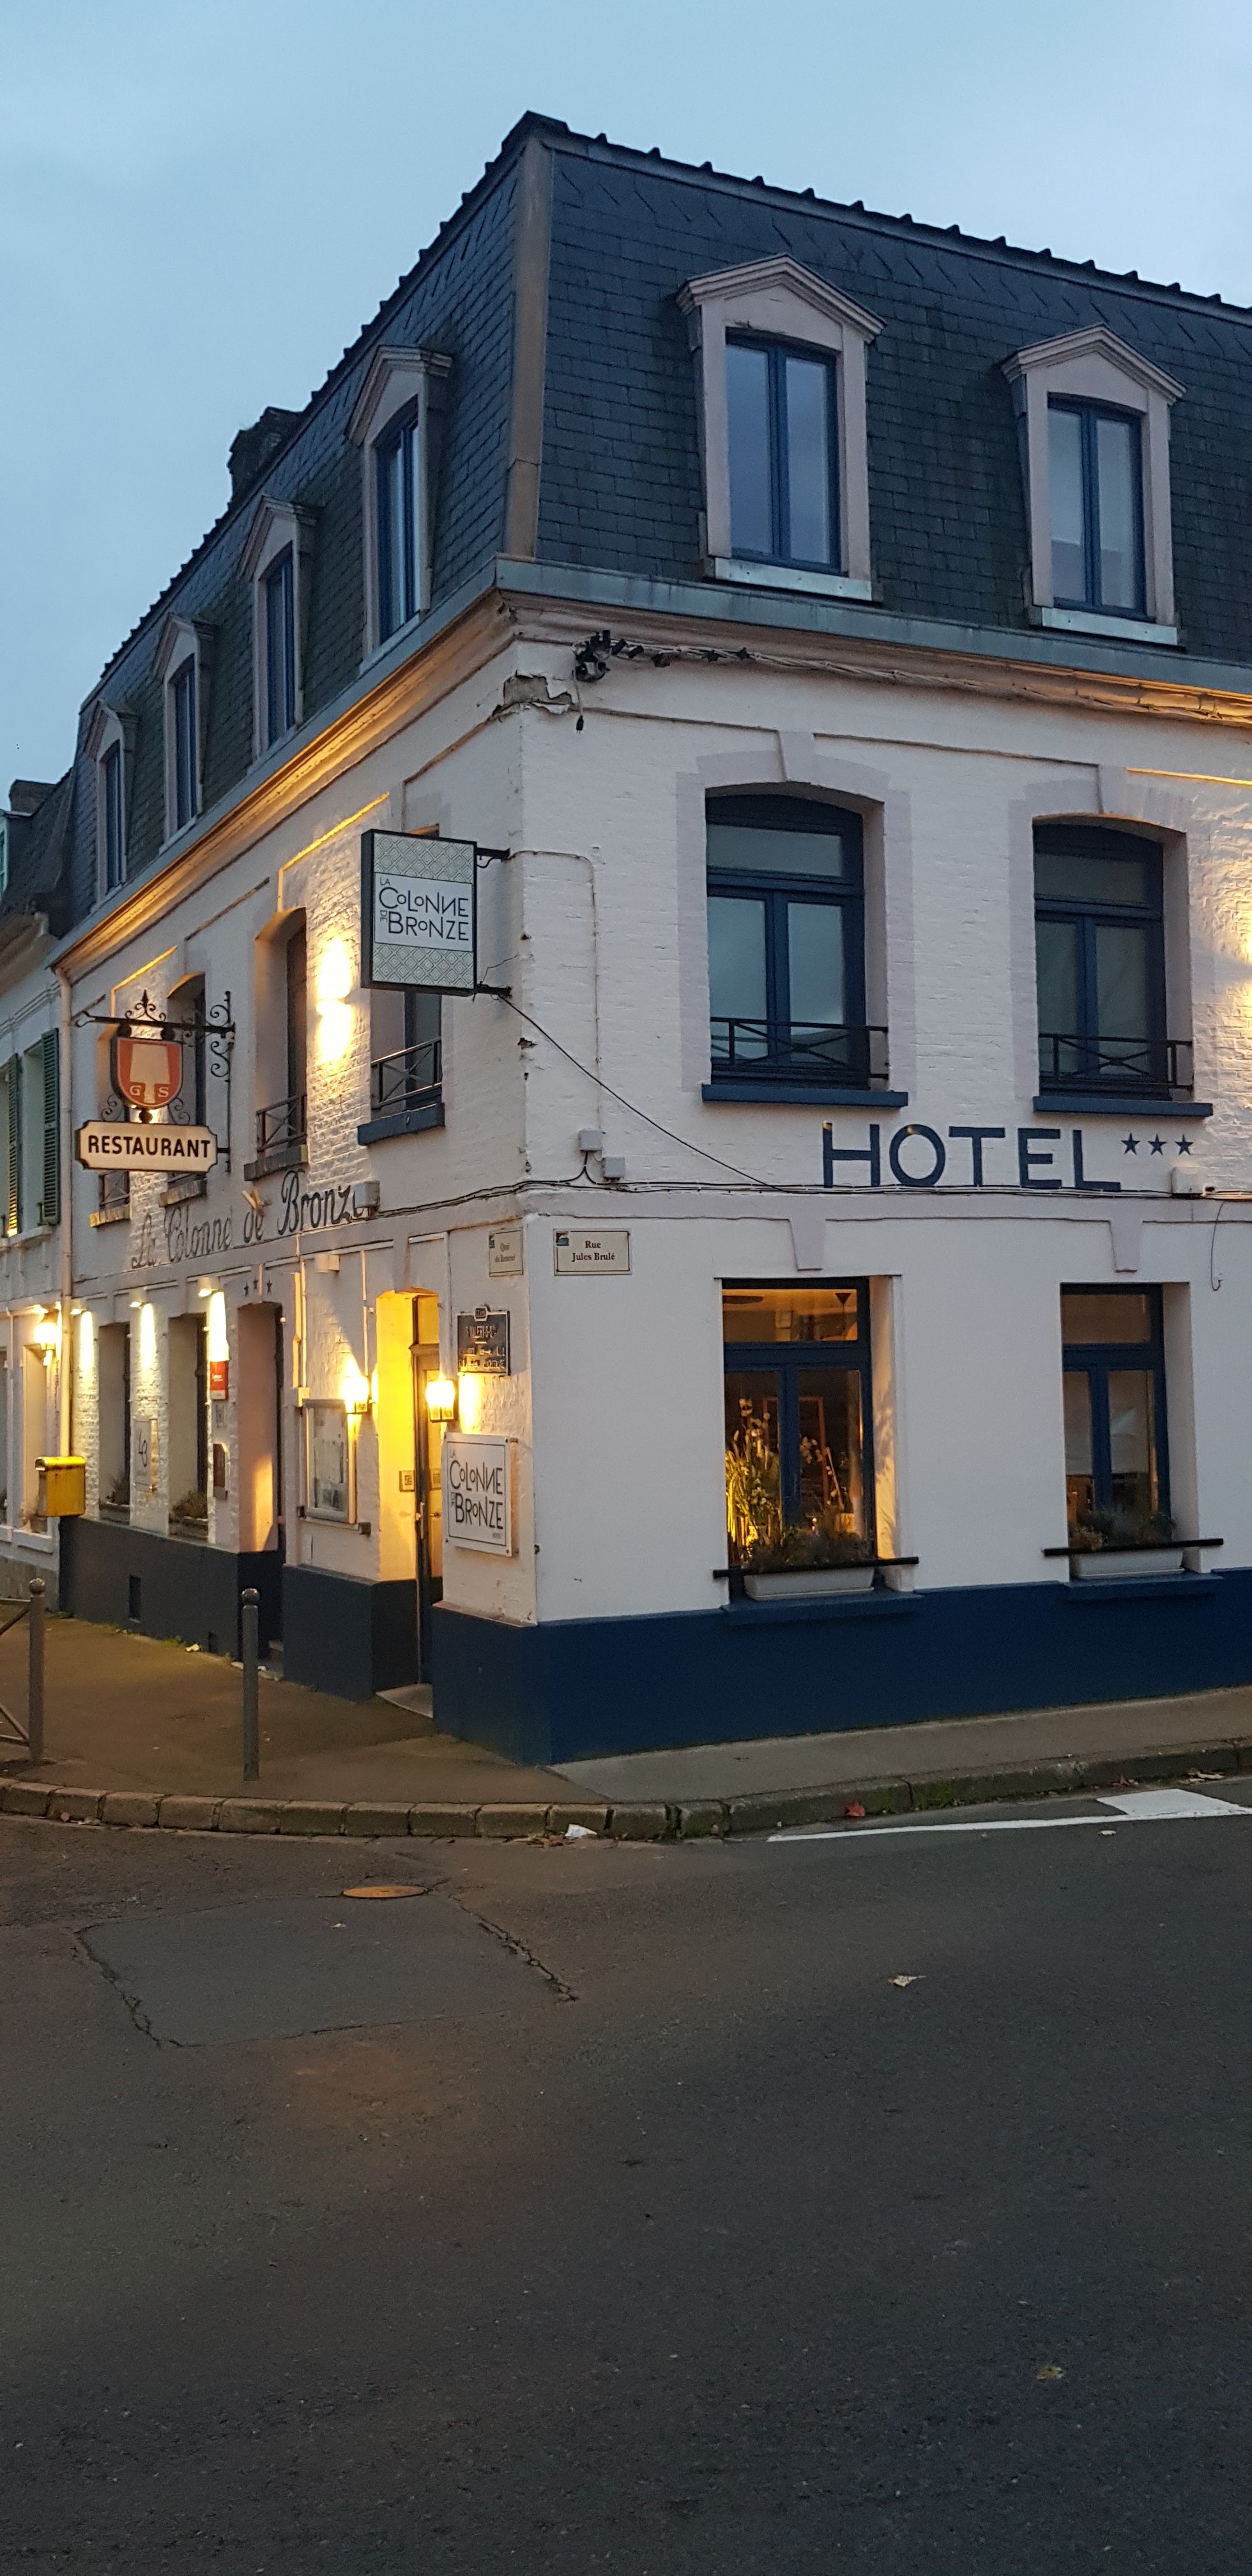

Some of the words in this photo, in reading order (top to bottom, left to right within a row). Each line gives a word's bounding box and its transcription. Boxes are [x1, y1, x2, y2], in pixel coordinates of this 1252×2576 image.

[379, 877, 390, 886] LA
[379, 910, 388, 923] DE
[129, 1085, 141, 1096] G
[158, 1087, 169, 1098] S
[88, 1135, 211, 1158] RESTAURANT
[822, 1122, 1121, 1191] HOTEL
[164, 1205, 233, 1262] Colonne
[584, 1240, 602, 1248] Rue
[571, 1252, 592, 1262] Jules
